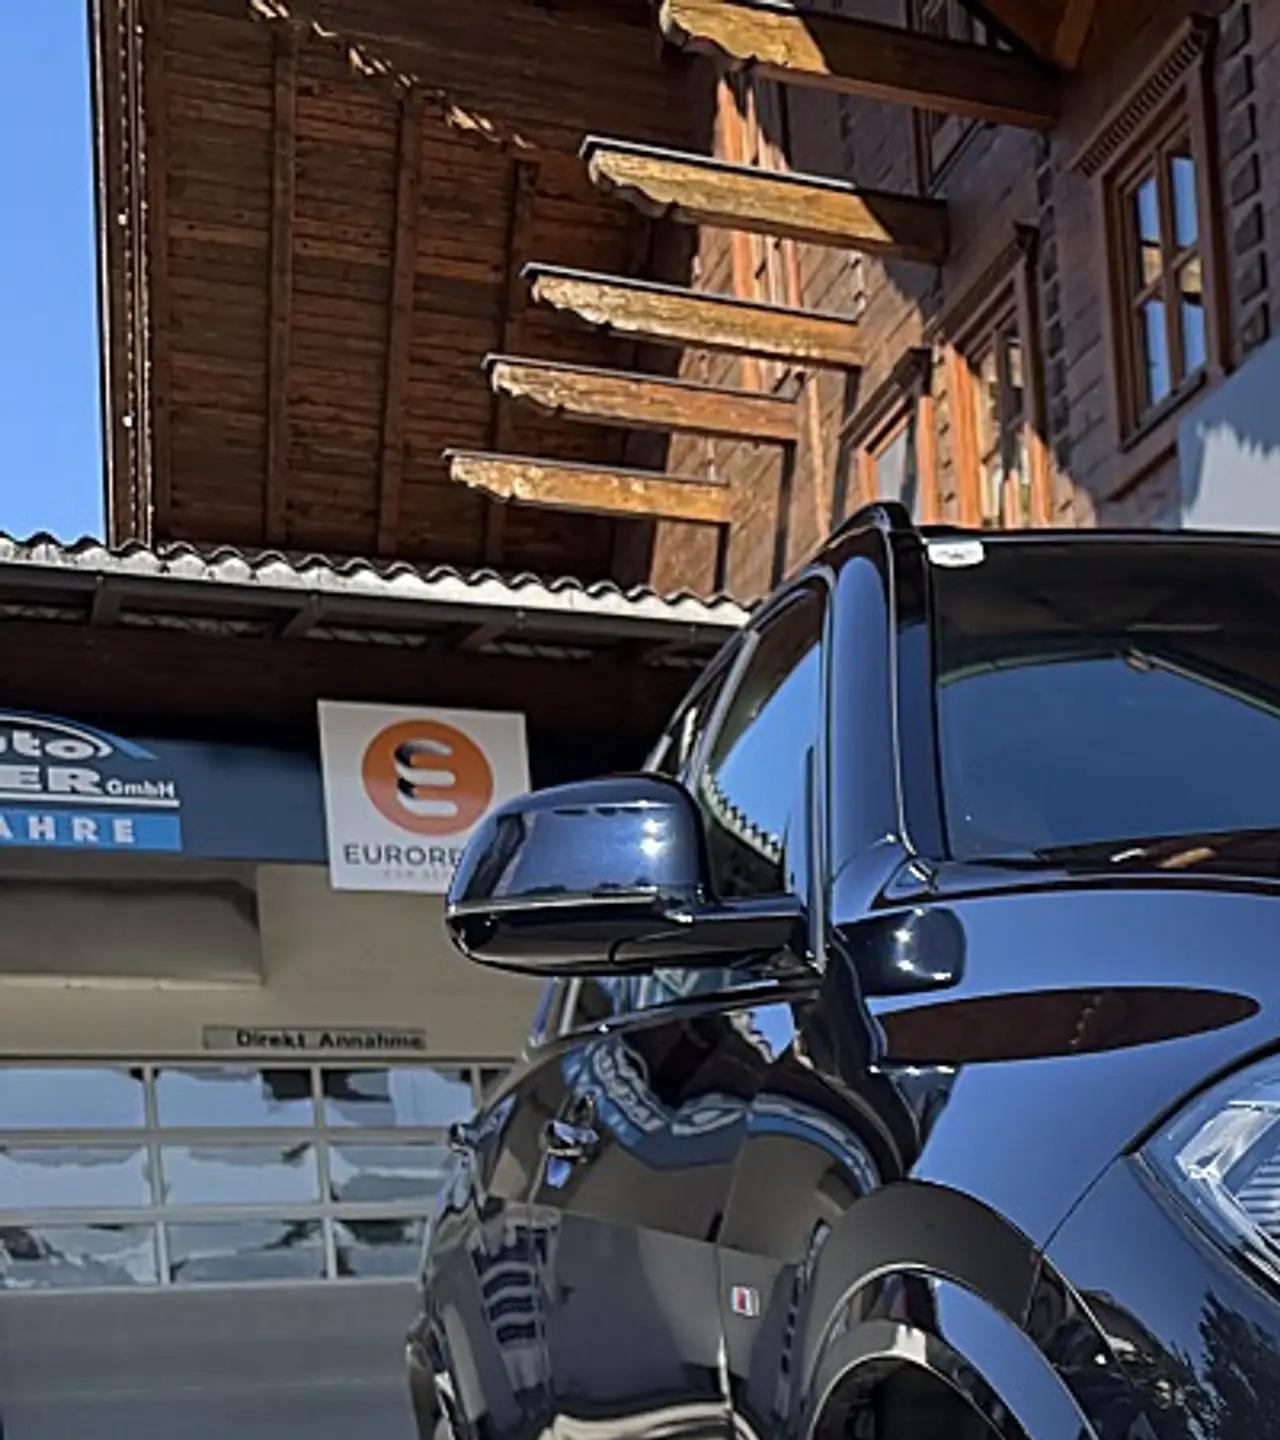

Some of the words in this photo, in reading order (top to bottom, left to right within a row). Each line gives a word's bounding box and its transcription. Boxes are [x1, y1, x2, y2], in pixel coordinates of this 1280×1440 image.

[105, 777, 175, 798] GmbH
[236, 1028, 306, 1049] Direkt
[318, 1029, 424, 1050] Annahme
